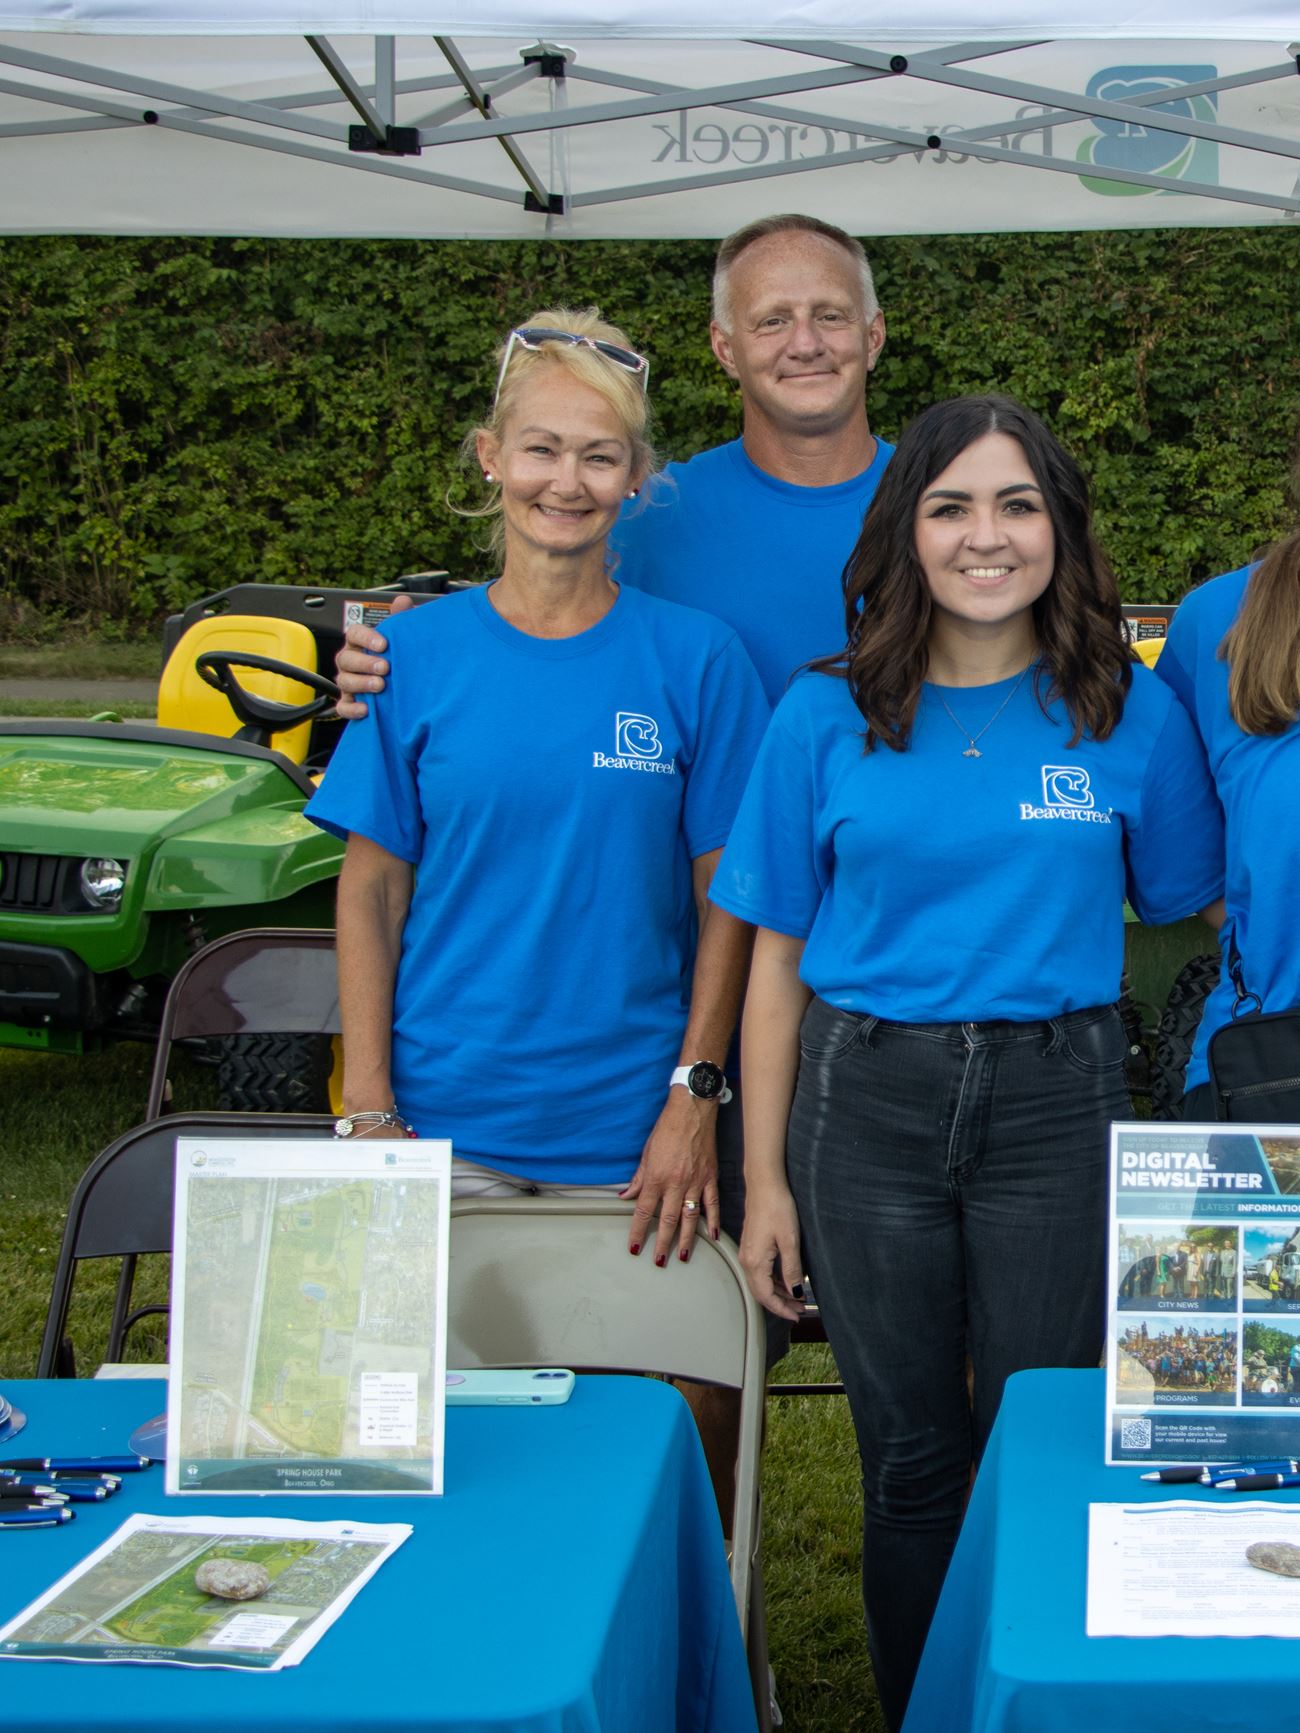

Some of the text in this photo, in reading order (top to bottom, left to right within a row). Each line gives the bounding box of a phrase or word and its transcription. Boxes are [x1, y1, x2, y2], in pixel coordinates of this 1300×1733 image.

[592, 751, 676, 775] Beavercreek
[1121, 1151, 1217, 1170] DIGITAL
[1121, 1172, 1263, 1189] NEWSLETTER
[1157, 1301, 1200, 1310] CITY NEWS
[1155, 1394, 1199, 1402] PROGRAMS
[302, 1468, 324, 1477] HOUSE
[325, 1468, 342, 1477] PARK
